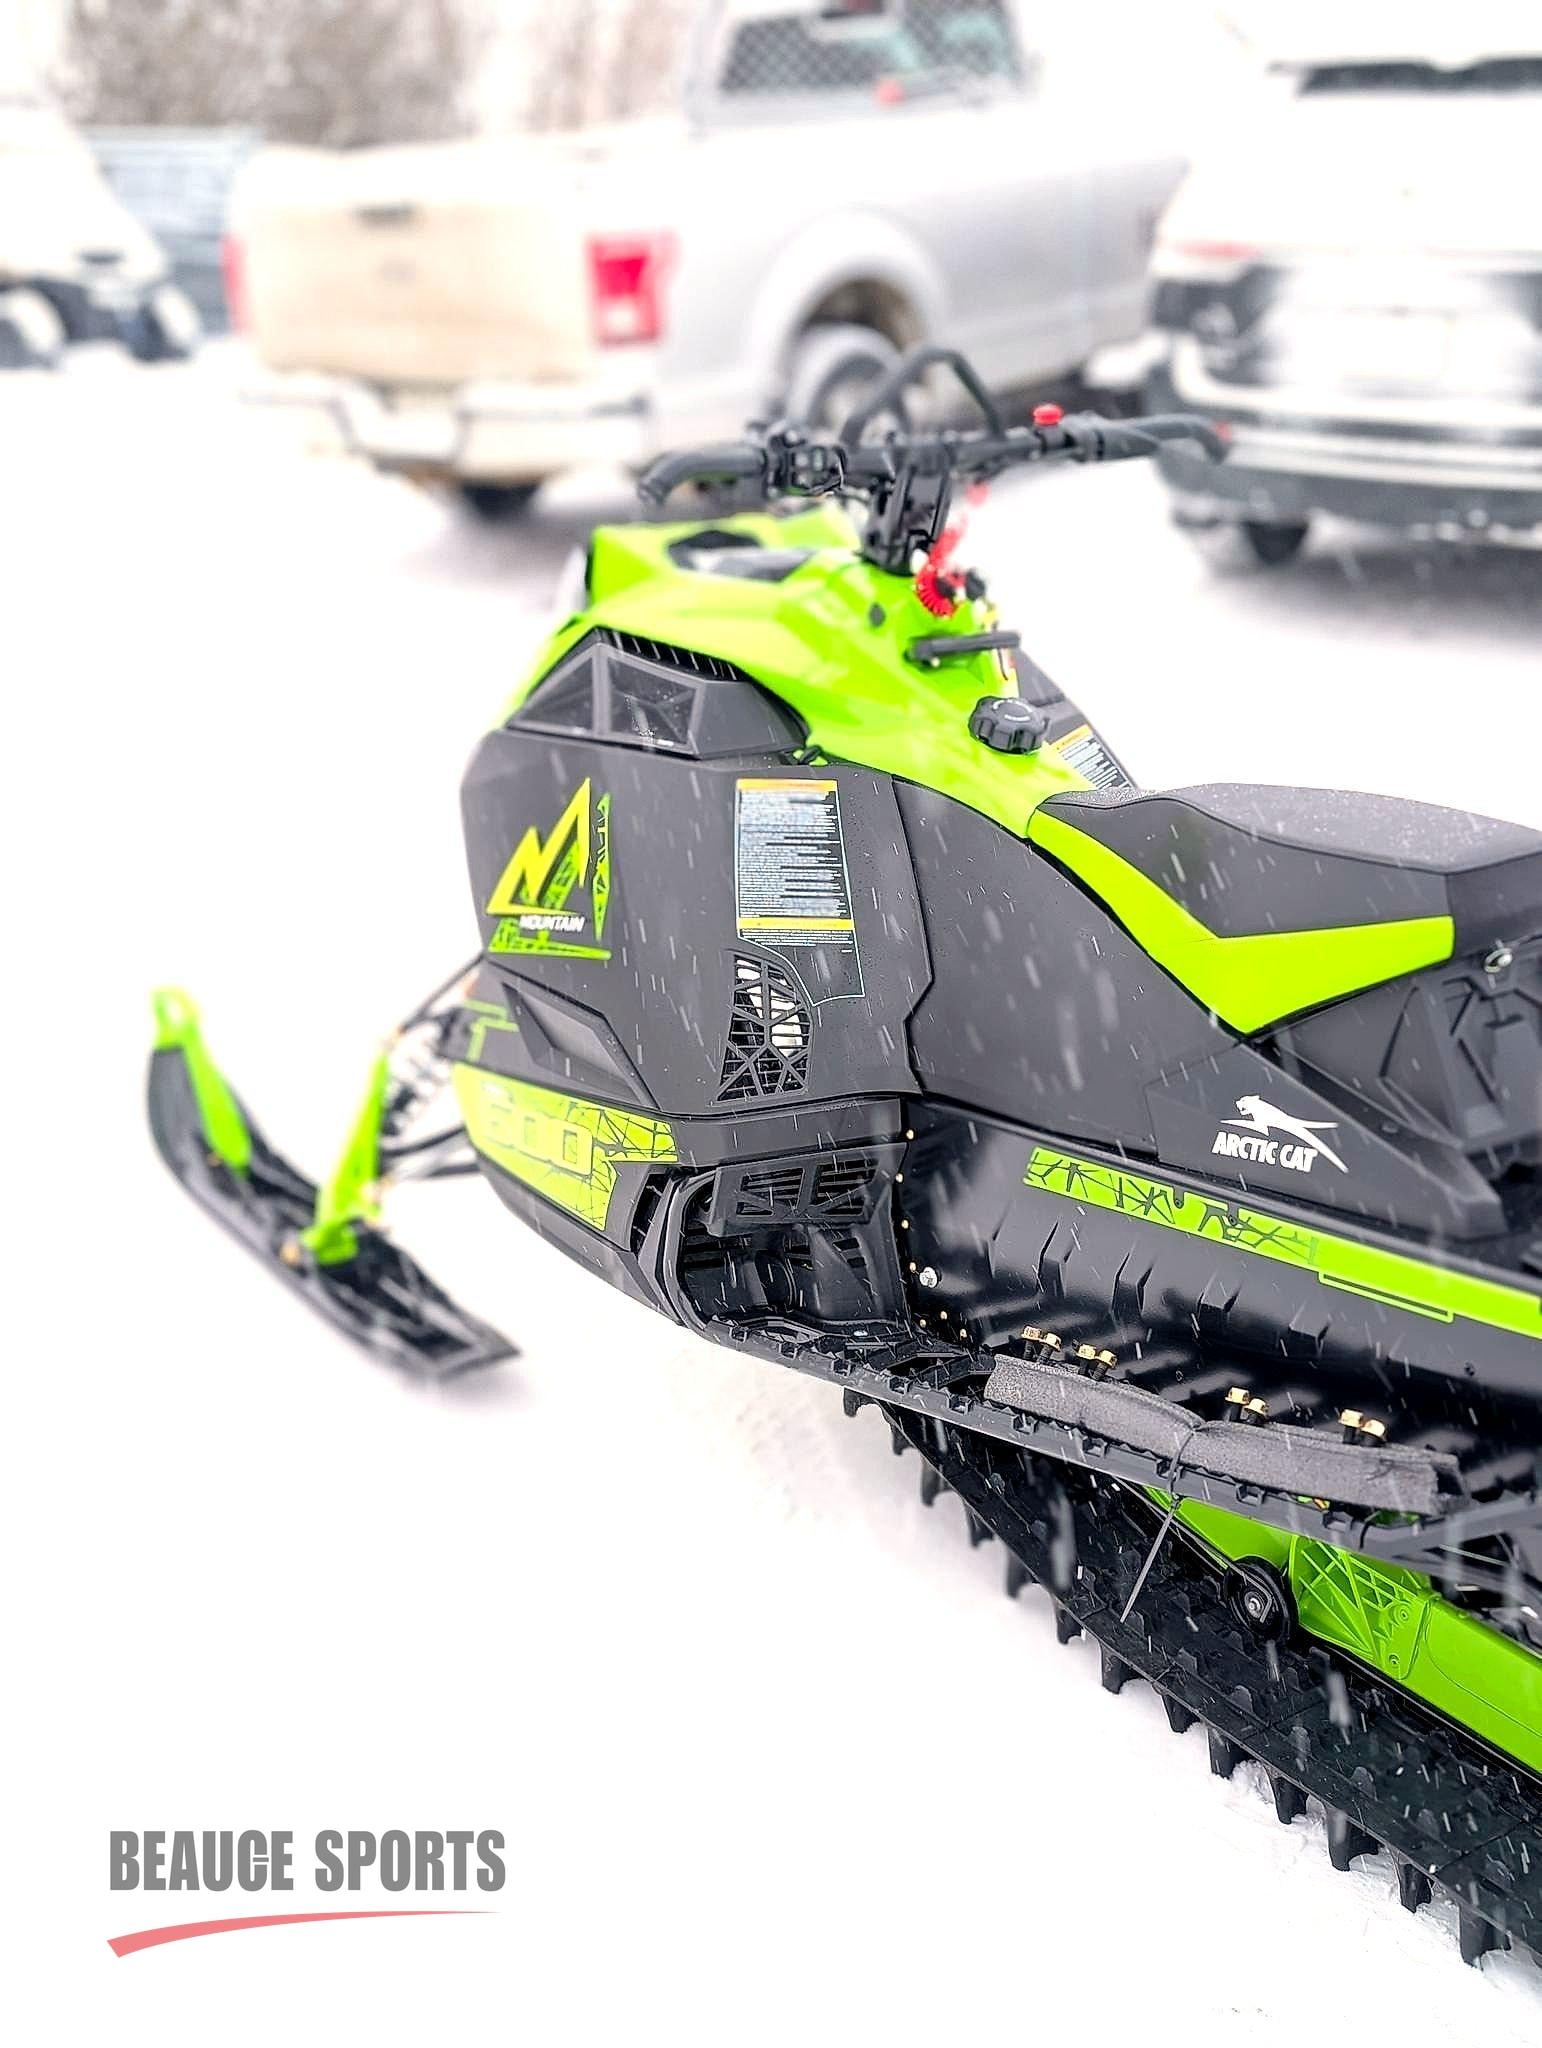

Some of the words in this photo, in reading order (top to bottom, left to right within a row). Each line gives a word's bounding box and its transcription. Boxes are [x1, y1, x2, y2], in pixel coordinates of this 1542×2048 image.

[519, 914, 586, 933] MOUNTAIN
[1211, 1131, 1279, 1165] ARCTIC
[1280, 1144, 1319, 1173] CAT
